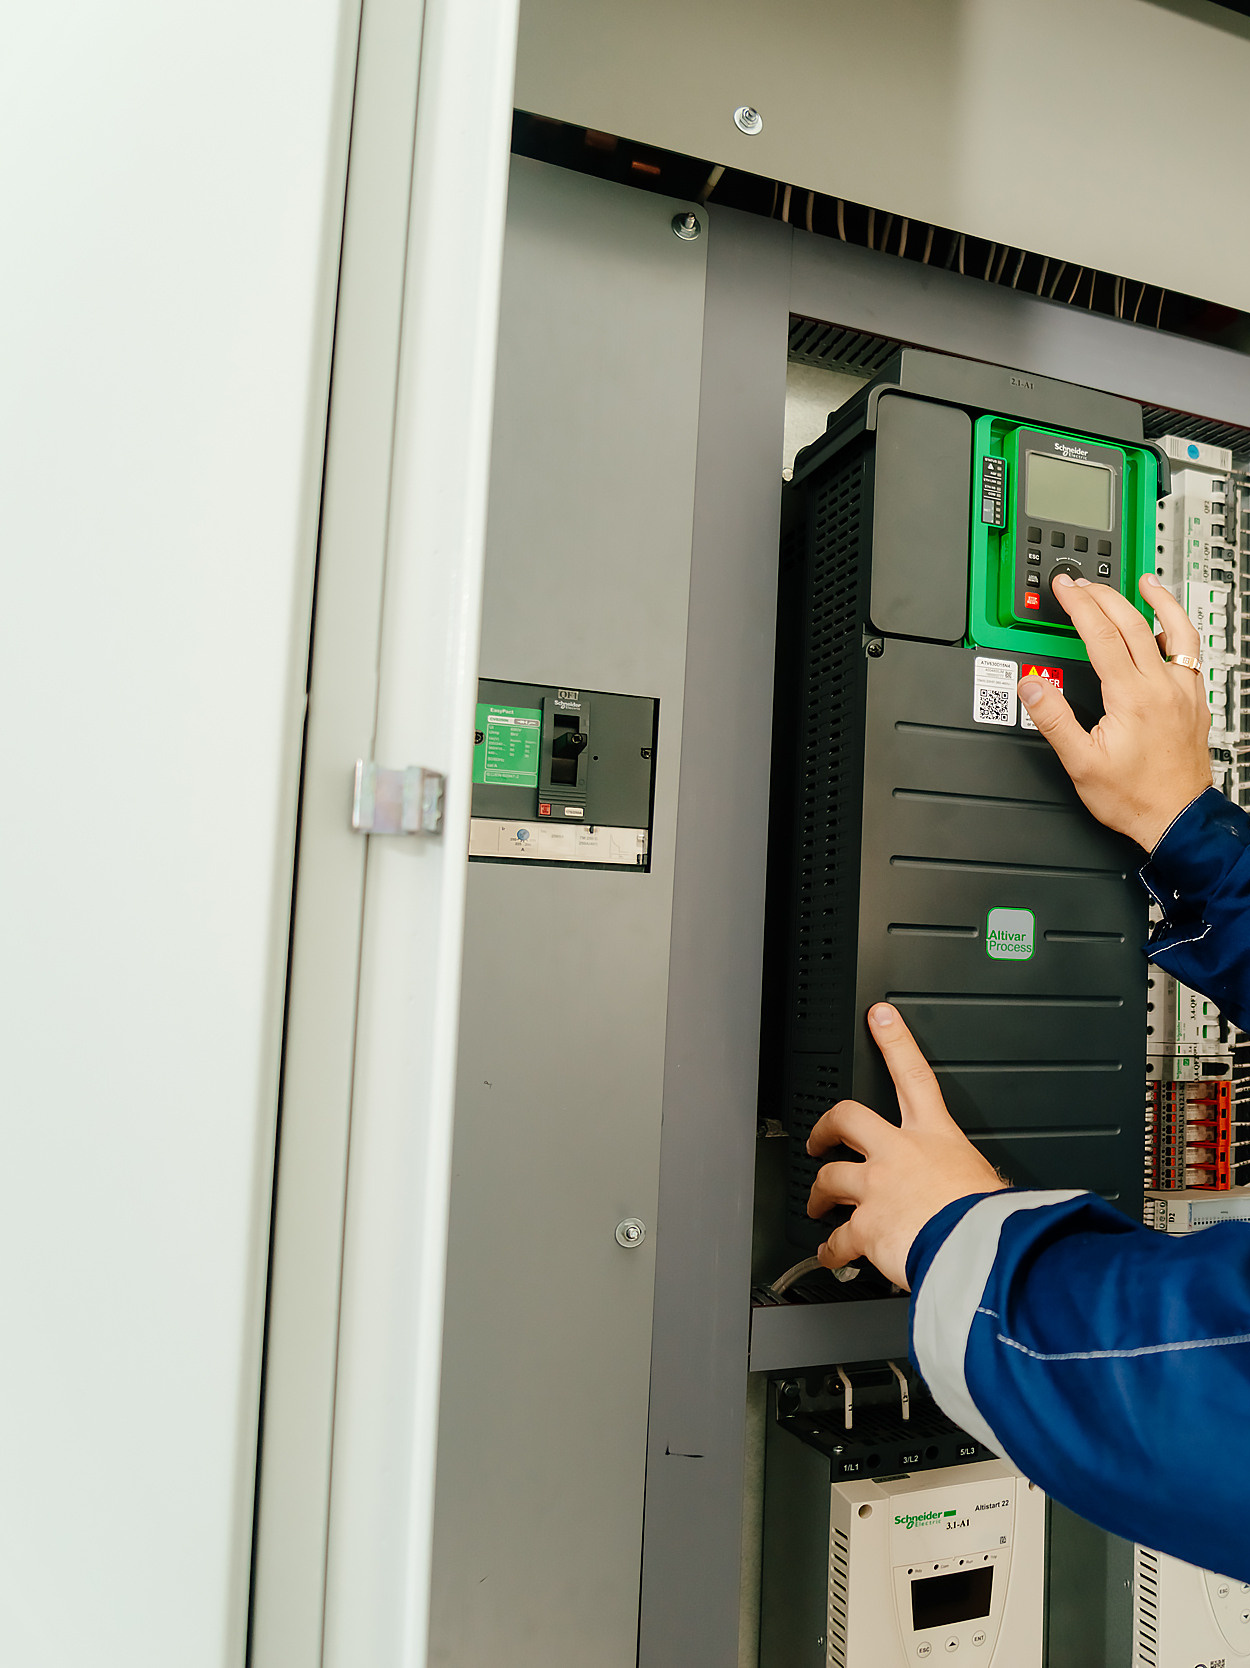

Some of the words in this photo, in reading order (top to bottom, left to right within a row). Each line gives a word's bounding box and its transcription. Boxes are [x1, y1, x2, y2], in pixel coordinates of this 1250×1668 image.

[1011, 378, 1034, 389] 2.1-A1
[1054, 442, 1088, 457] Schneider
[1028, 553, 1040, 561] ESC
[559, 691, 577, 700] QF1
[988, 930, 1027, 941] Altivar
[989, 940, 1032, 953] Process
[1168, 1213, 1175, 1222] D2
[960, 1447, 975, 1456] 5/L3
[903, 1455, 919, 1464] 3/L2
[844, 1463, 859, 1471] 1/L1
[975, 1502, 1000, 1511] Altistart
[894, 1511, 942, 1529] Schneider
[946, 1519, 970, 1530] 3.1-A1
